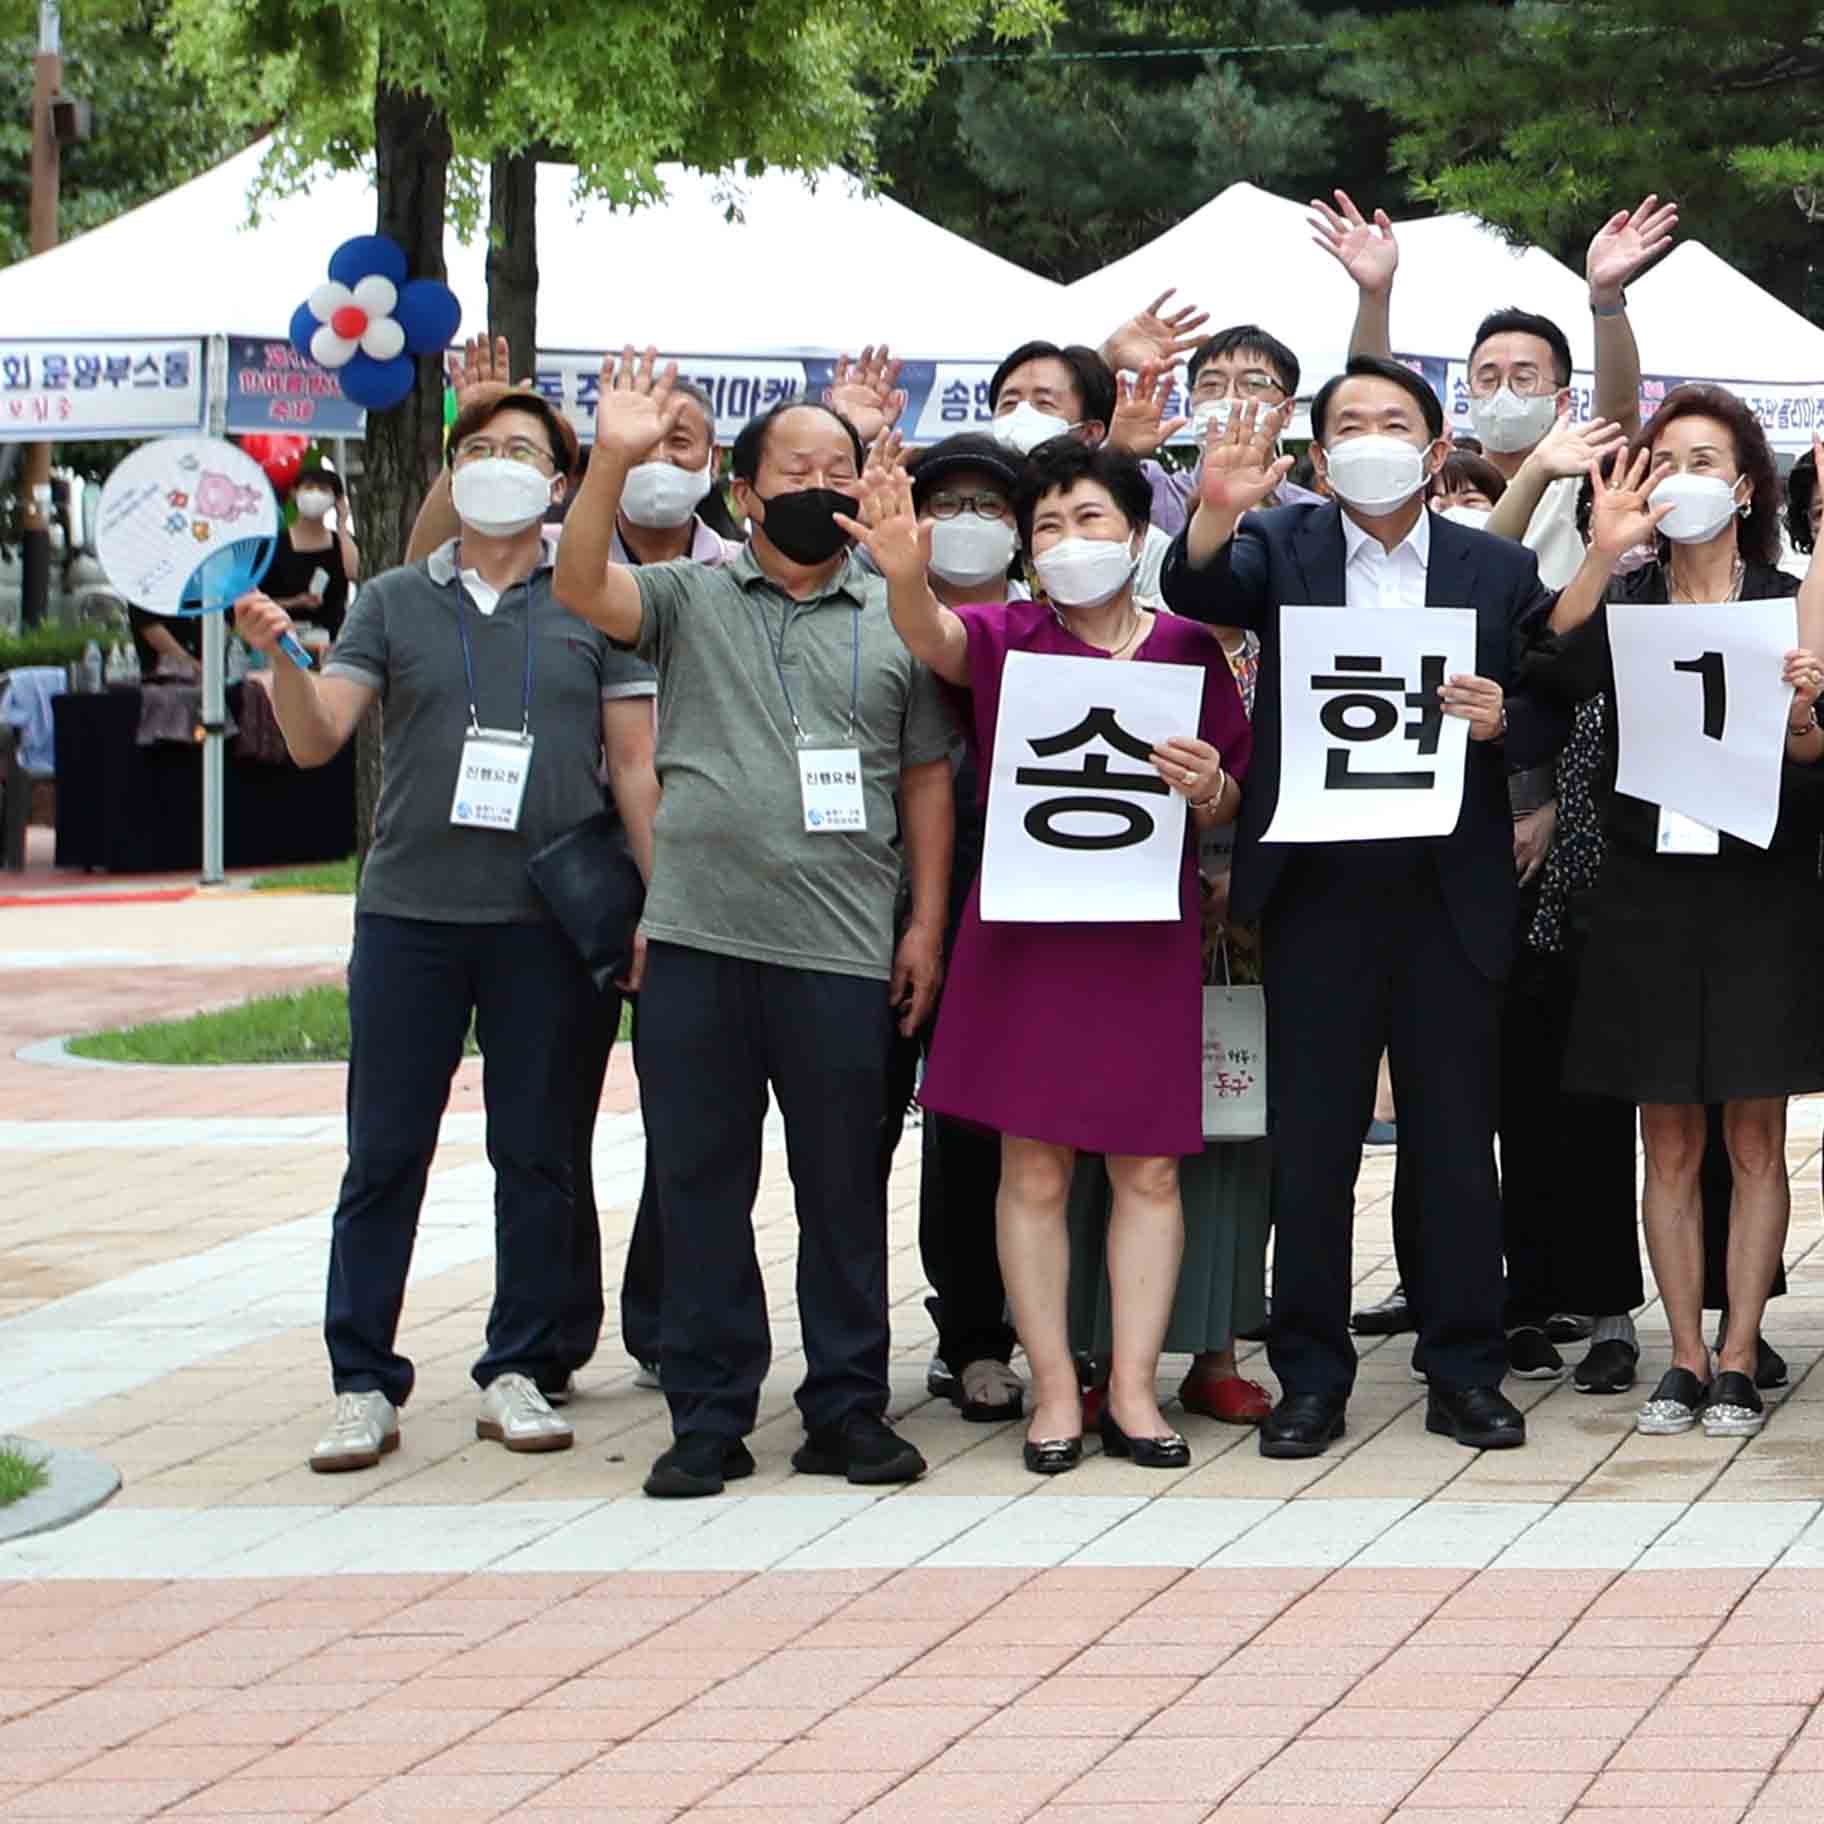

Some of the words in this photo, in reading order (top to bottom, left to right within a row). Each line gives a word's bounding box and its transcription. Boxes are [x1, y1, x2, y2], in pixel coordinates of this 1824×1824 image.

[1015, 706, 1172, 851] 송
[1310, 655, 1447, 790] 현
[1673, 651, 1727, 742] 1
